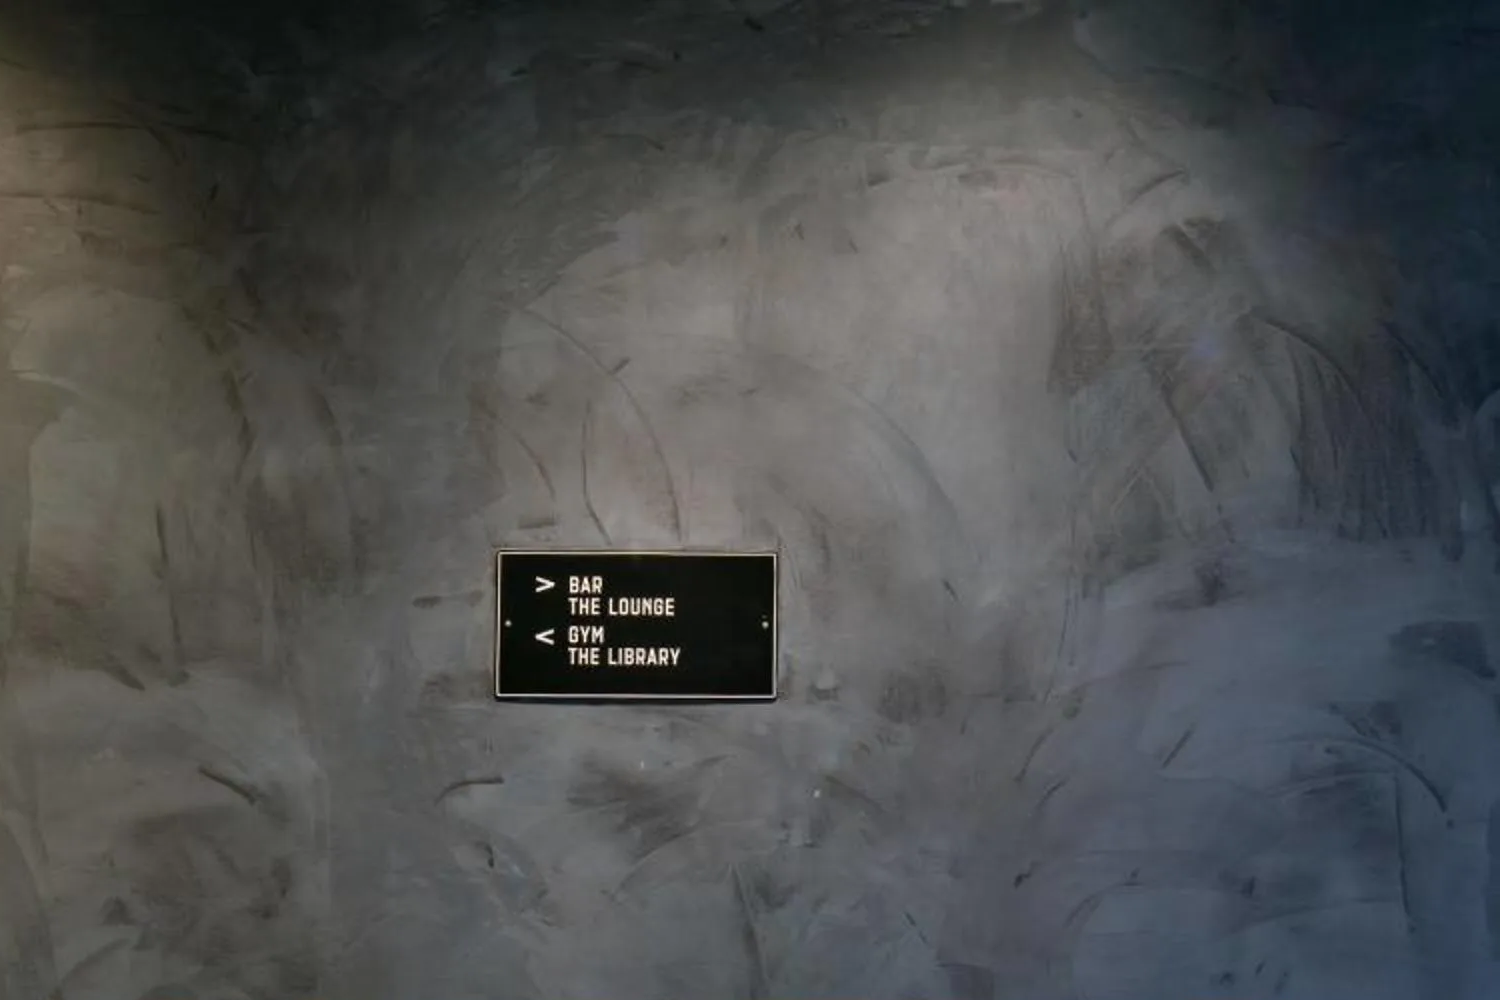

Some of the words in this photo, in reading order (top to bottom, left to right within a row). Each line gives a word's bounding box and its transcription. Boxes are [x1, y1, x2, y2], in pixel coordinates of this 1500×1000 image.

[569, 576, 603, 593] BAR
[569, 598, 600, 616] THE
[608, 598, 675, 616] LOUNGE
[568, 626, 605, 643] GYM
[568, 648, 600, 665] THE
[608, 648, 681, 665] LIBRARY
